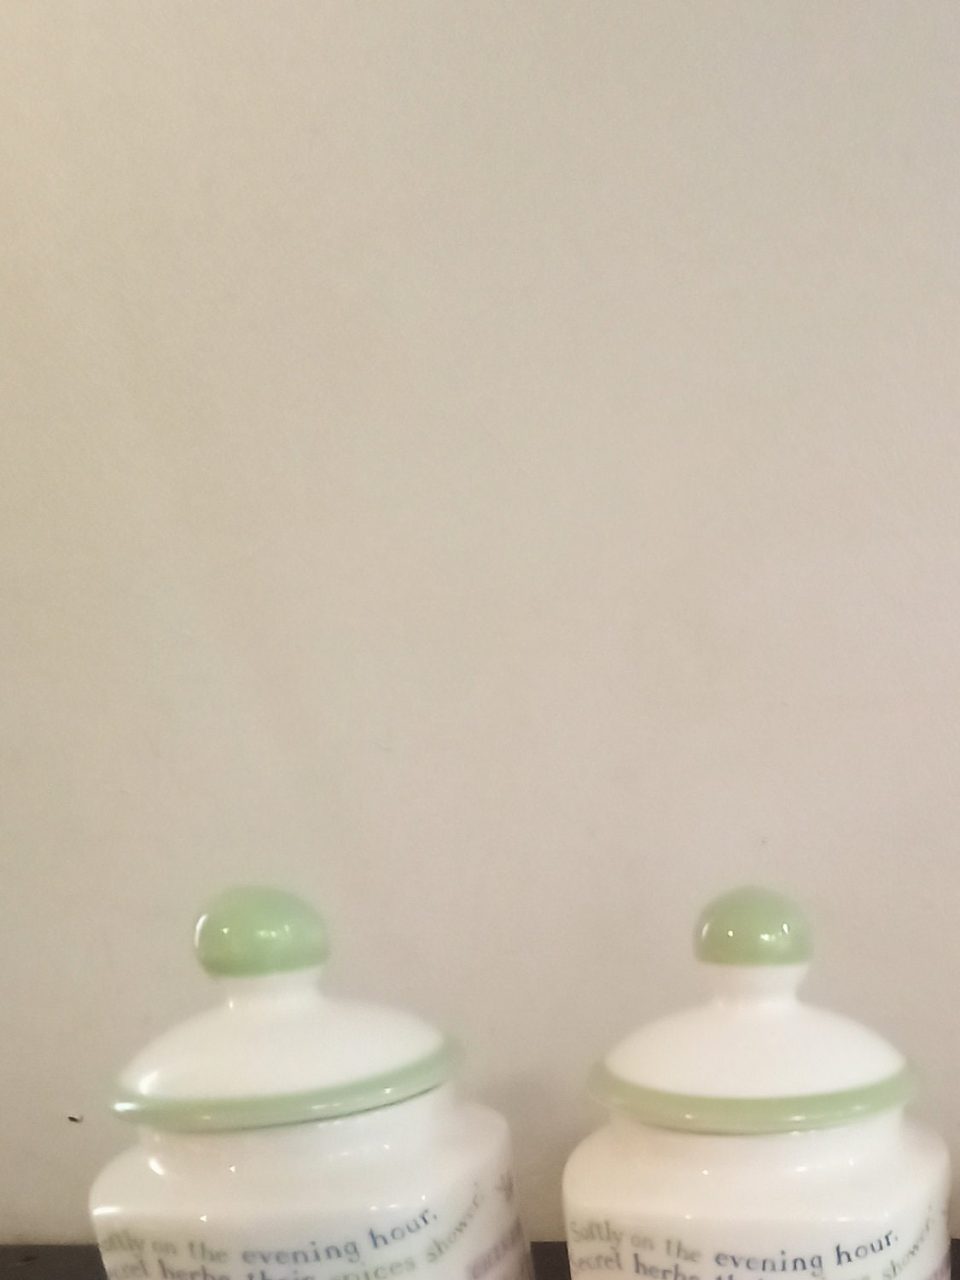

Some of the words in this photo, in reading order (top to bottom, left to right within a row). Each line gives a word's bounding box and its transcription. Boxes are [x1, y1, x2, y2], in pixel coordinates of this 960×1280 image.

[187, 1240, 228, 1263] the
[241, 1240, 360, 1263] evening
[664, 1239, 701, 1263] the
[714, 1249, 823, 1278] evening
